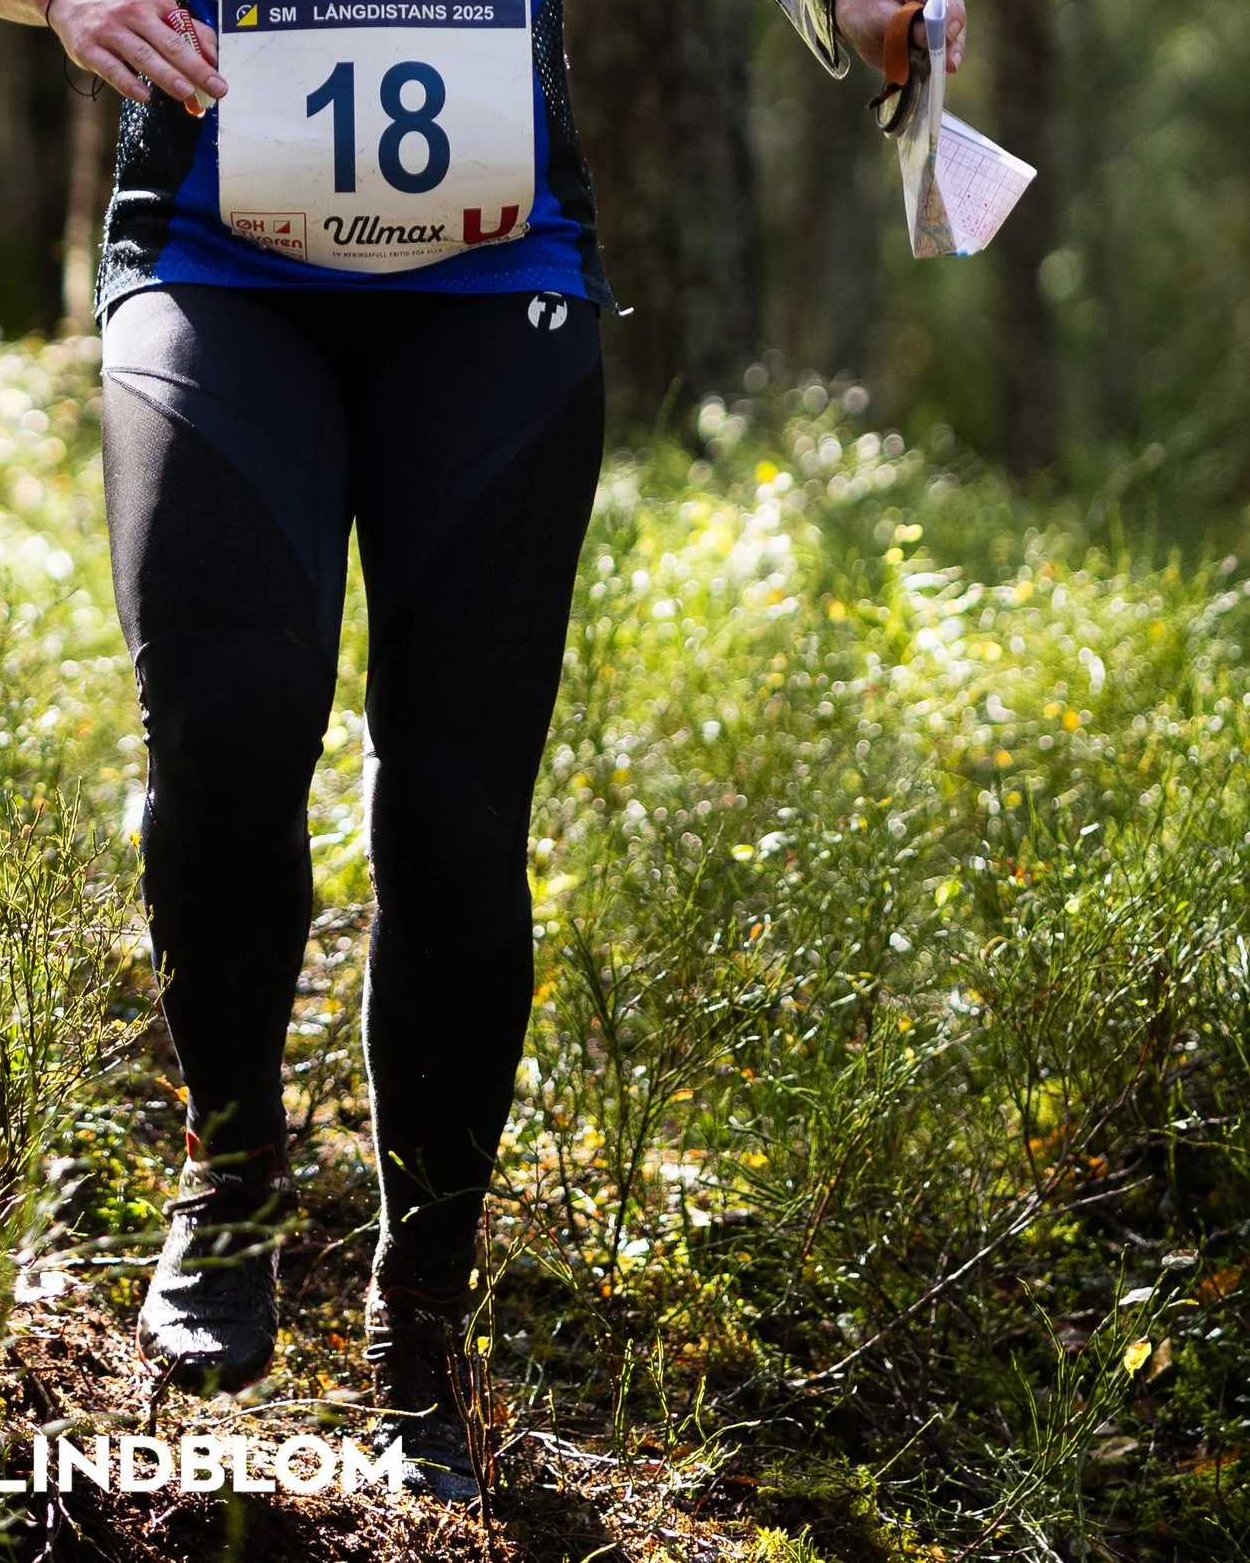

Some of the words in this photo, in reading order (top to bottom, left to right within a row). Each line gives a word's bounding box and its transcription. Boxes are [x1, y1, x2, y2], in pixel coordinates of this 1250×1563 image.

[269, 6, 297, 23] SM
[313, 2, 448, 21] LÅNGDISTANS
[452, 5, 495, 20] 2025
[306, 60, 451, 194] 18
[323, 215, 445, 246] Ullmax
[427, 247, 443, 255] ALLA
